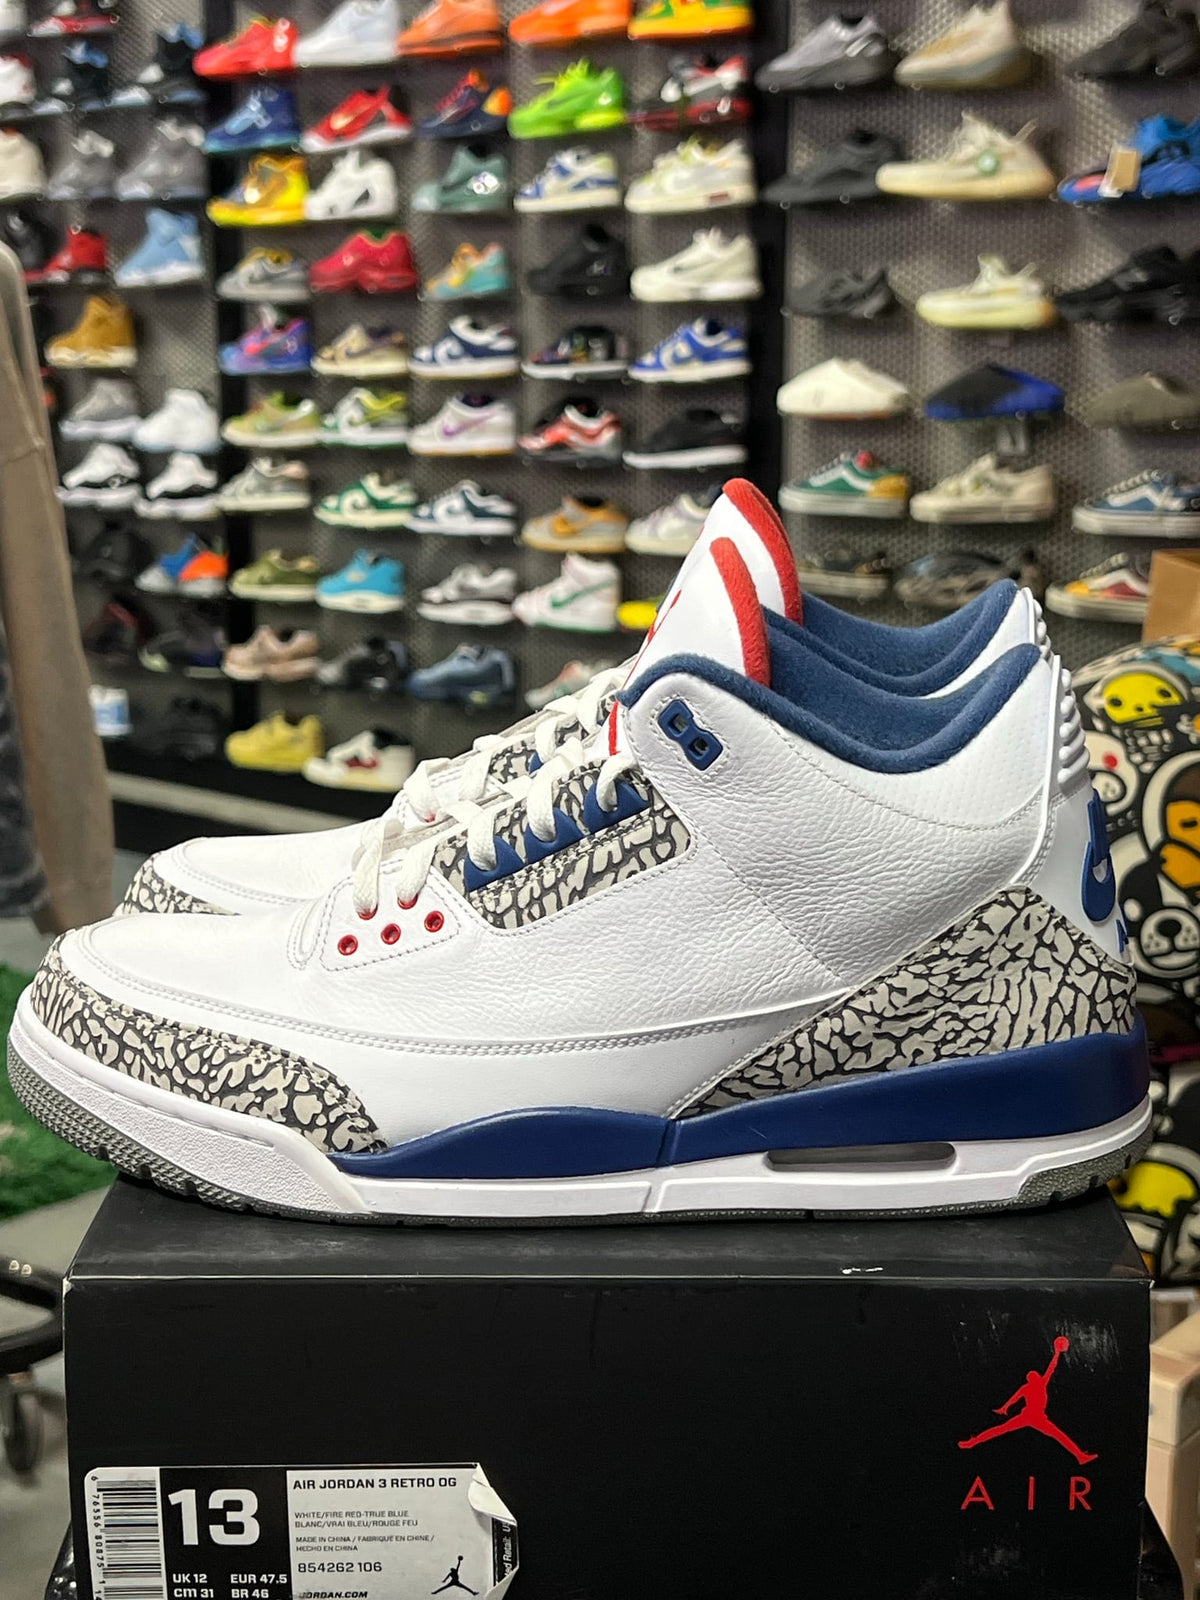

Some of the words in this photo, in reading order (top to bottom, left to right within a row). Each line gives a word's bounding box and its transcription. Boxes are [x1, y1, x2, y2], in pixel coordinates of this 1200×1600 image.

[293, 1479, 316, 1490] AIR
[319, 1478, 375, 1489] JORDAN
[378, 1478, 387, 1488] 3
[390, 1477, 435, 1488] RETRO
[438, 1477, 457, 1487] OG
[960, 1475, 1092, 1511] AIR
[168, 1488, 261, 1546] 13
[294, 1511, 344, 1519] WHITE/FIRE
[387, 1510, 409, 1518] BLUE
[294, 1520, 346, 1528] BLANC/VRAI
[347, 1519, 401, 1528] BLEU/ROUGE
[402, 1519, 418, 1527] FEU
[357, 1535, 394, 1543] FABRIQUE
[406, 1534, 430, 1542] CHINE
[298, 1562, 354, 1573] 854262
[357, 1561, 382, 1573] 106
[172, 1573, 191, 1584] UK
[193, 1573, 208, 1584] 12
[230, 1573, 257, 1584] EUR
[259, 1573, 288, 1584] 47.5
[200, 1588, 215, 1598] 31
[231, 1588, 249, 1598] BR
[251, 1588, 270, 1598] 46
[299, 1591, 369, 1599] JORDAN.COM
